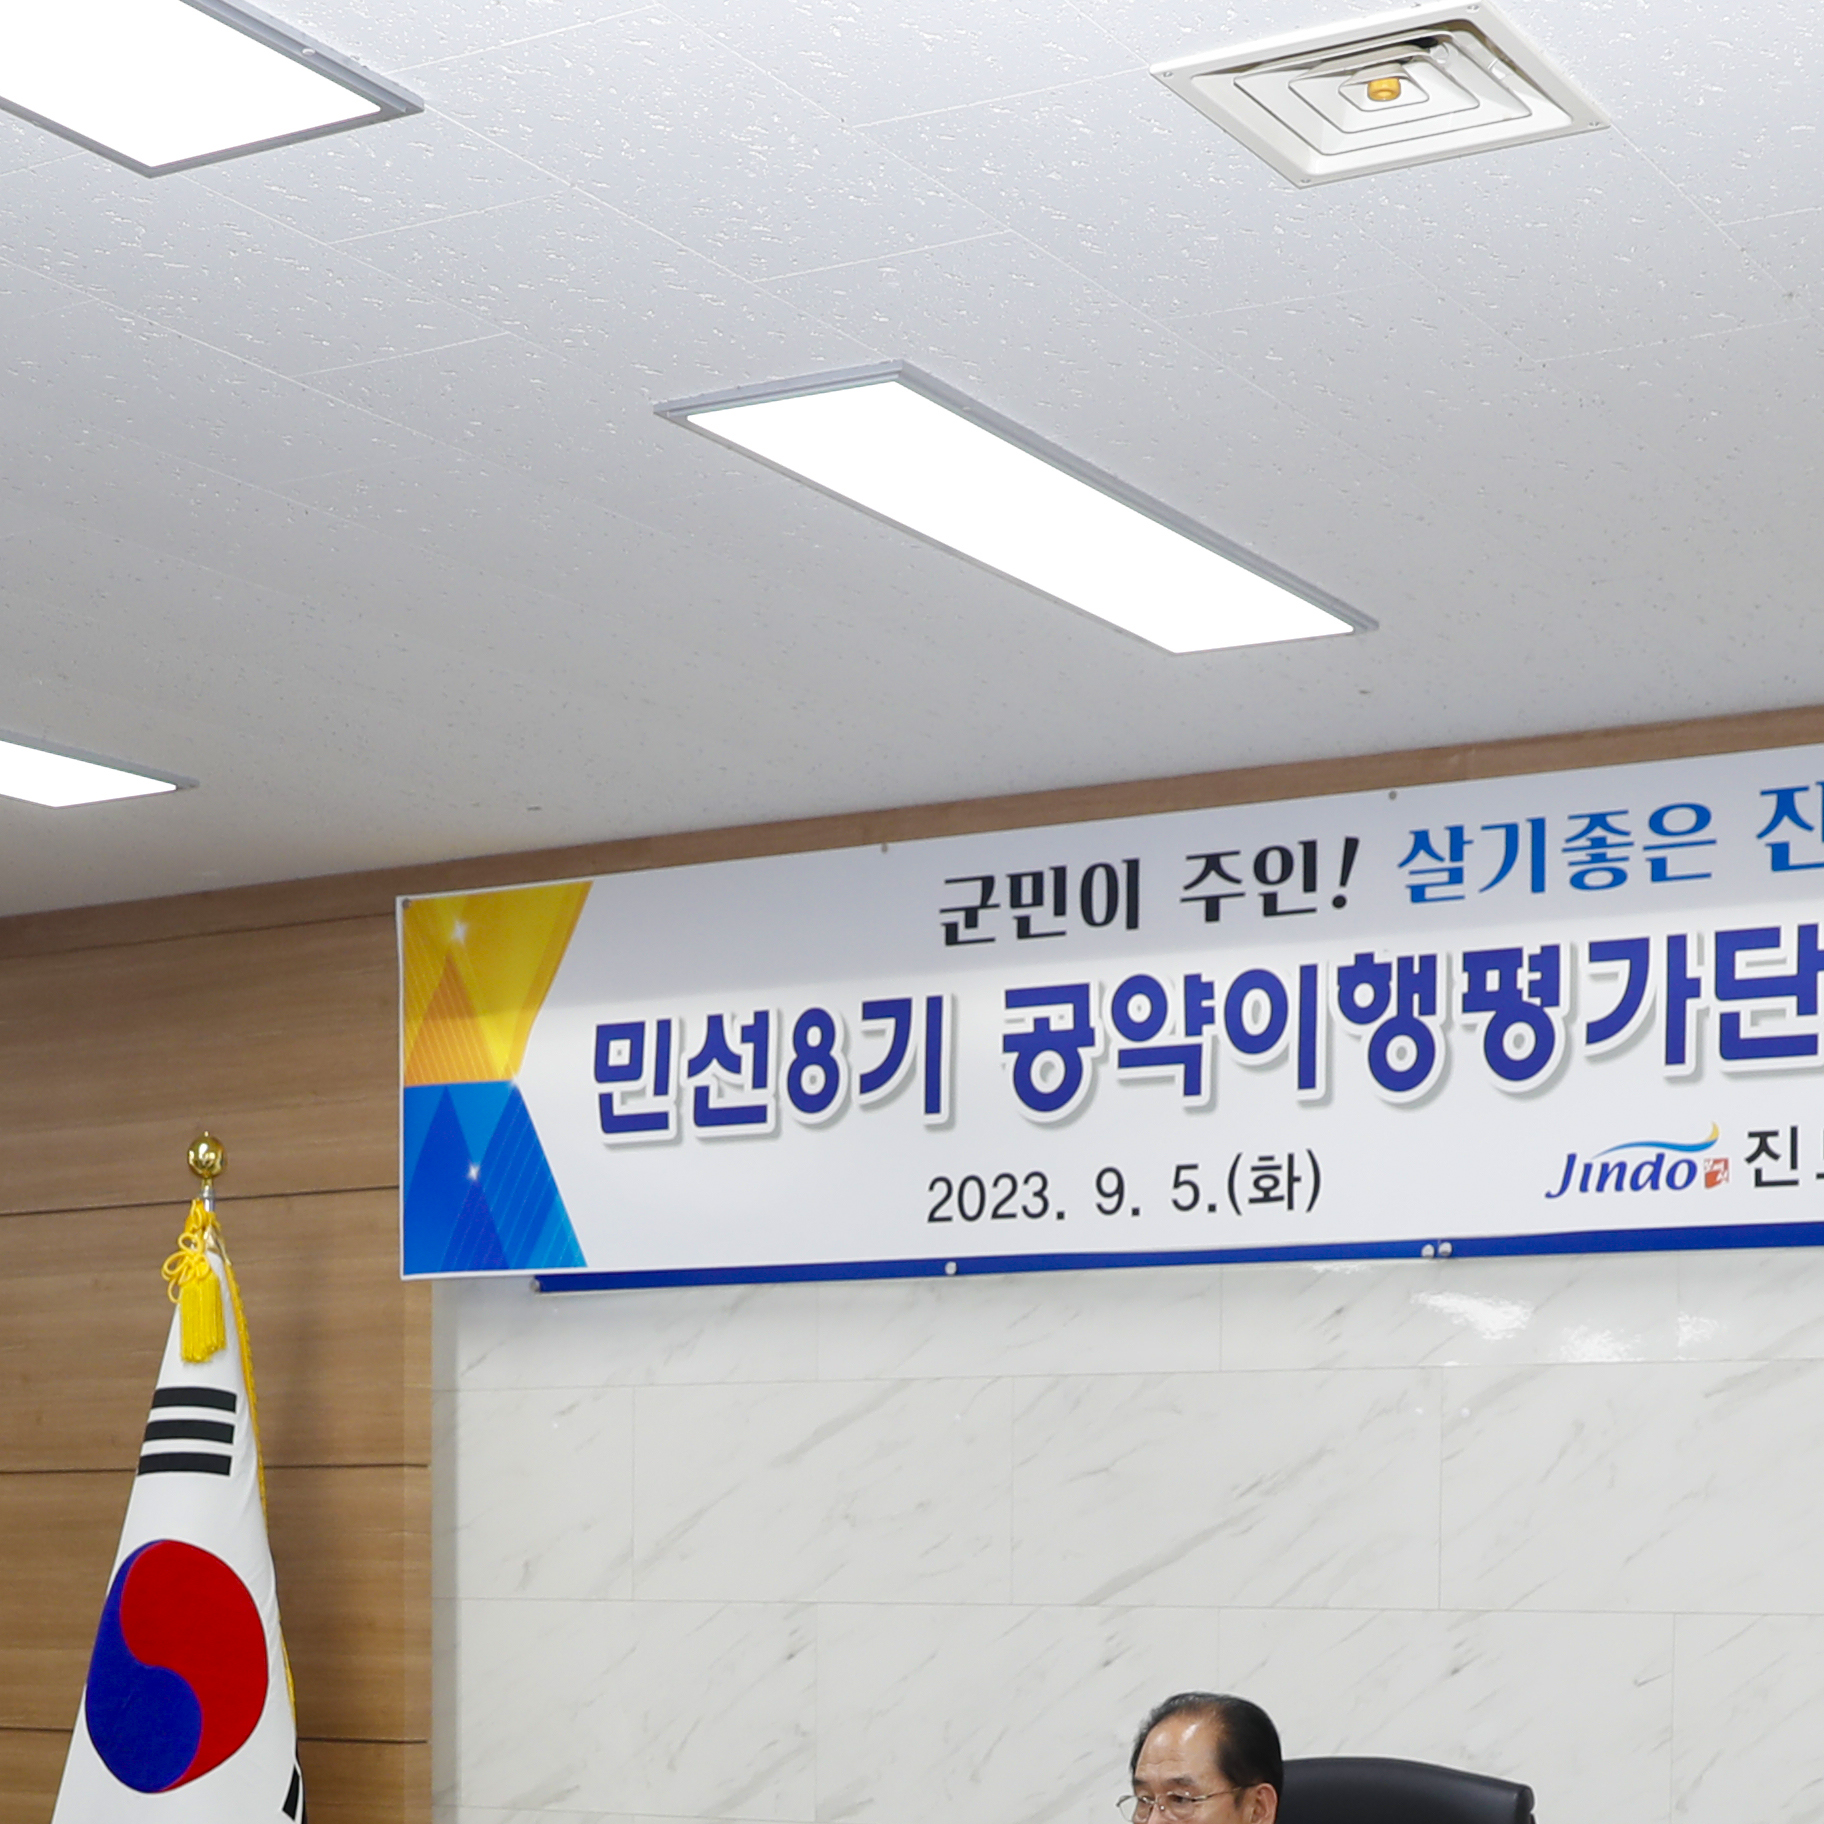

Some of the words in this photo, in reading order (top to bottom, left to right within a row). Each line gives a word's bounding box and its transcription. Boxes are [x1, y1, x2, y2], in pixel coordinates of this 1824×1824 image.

[939, 857, 1142, 947] 군민이
[1179, 836, 1361, 923] 주인!
[1396, 801, 1718, 904] 살기좋은
[593, 994, 945, 1135] 민선8기
[927, 1171, 1066, 1224] 2023.
[1095, 1166, 1141, 1216] 9.
[1170, 1148, 1323, 1218] 5.(화)
[1544, 1151, 1698, 1199] Jindo
